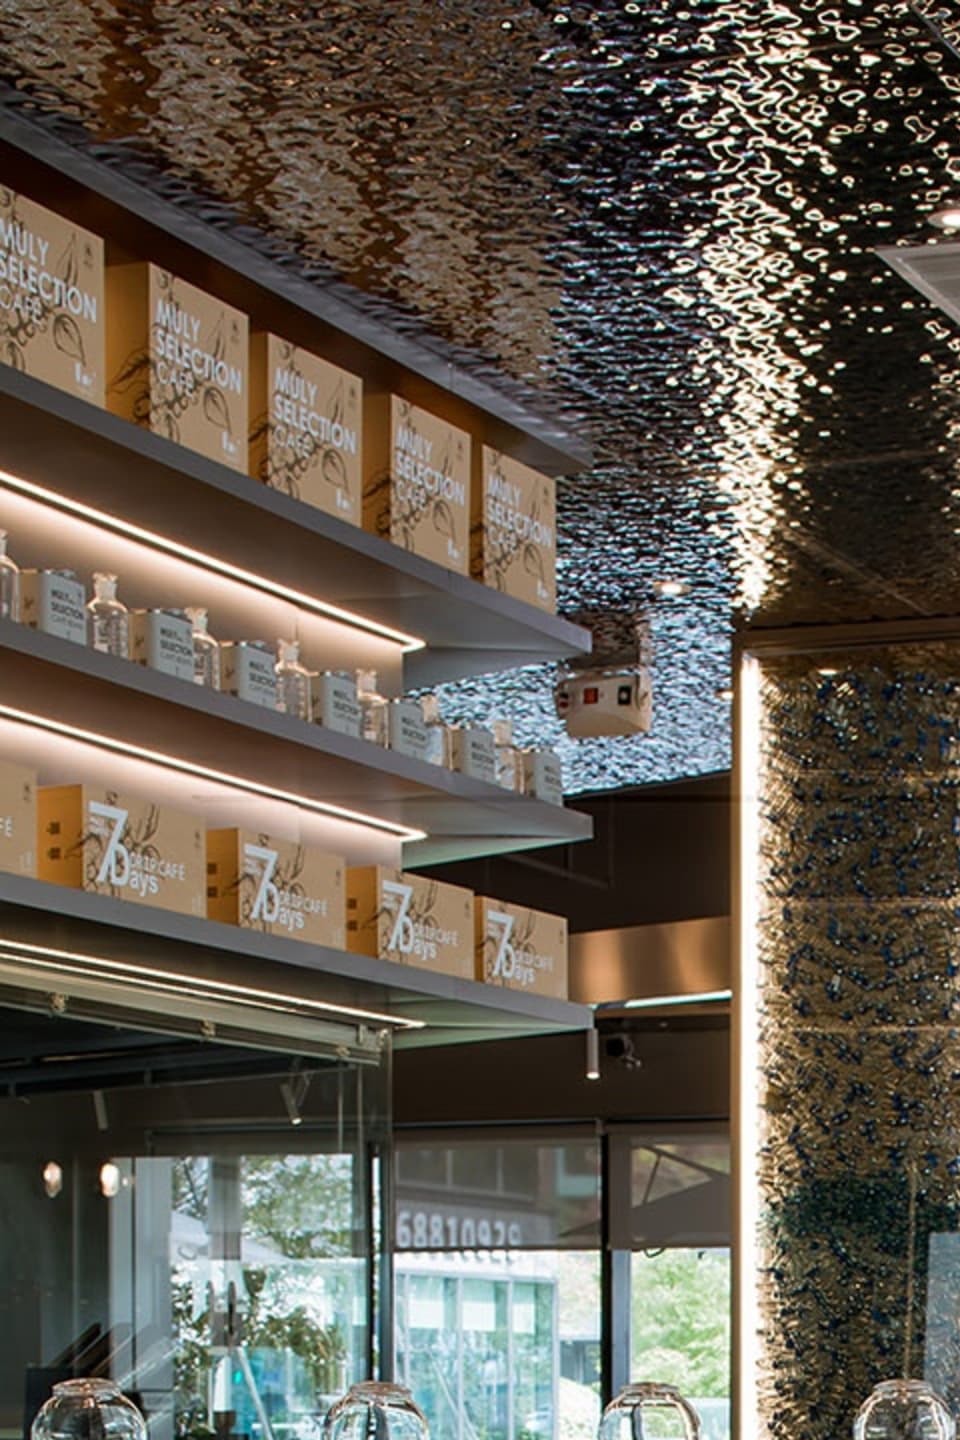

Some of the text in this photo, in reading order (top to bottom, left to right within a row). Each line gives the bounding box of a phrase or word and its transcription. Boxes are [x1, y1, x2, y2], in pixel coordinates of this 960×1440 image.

[0, 217, 49, 266] MULY
[0, 249, 97, 324] SELECTION
[157, 297, 200, 342] MULY
[155, 329, 242, 394] SELECTION
[275, 367, 318, 407] MULY
[273, 393, 356, 455] SELECTION
[395, 451, 465, 507] SELECTION
